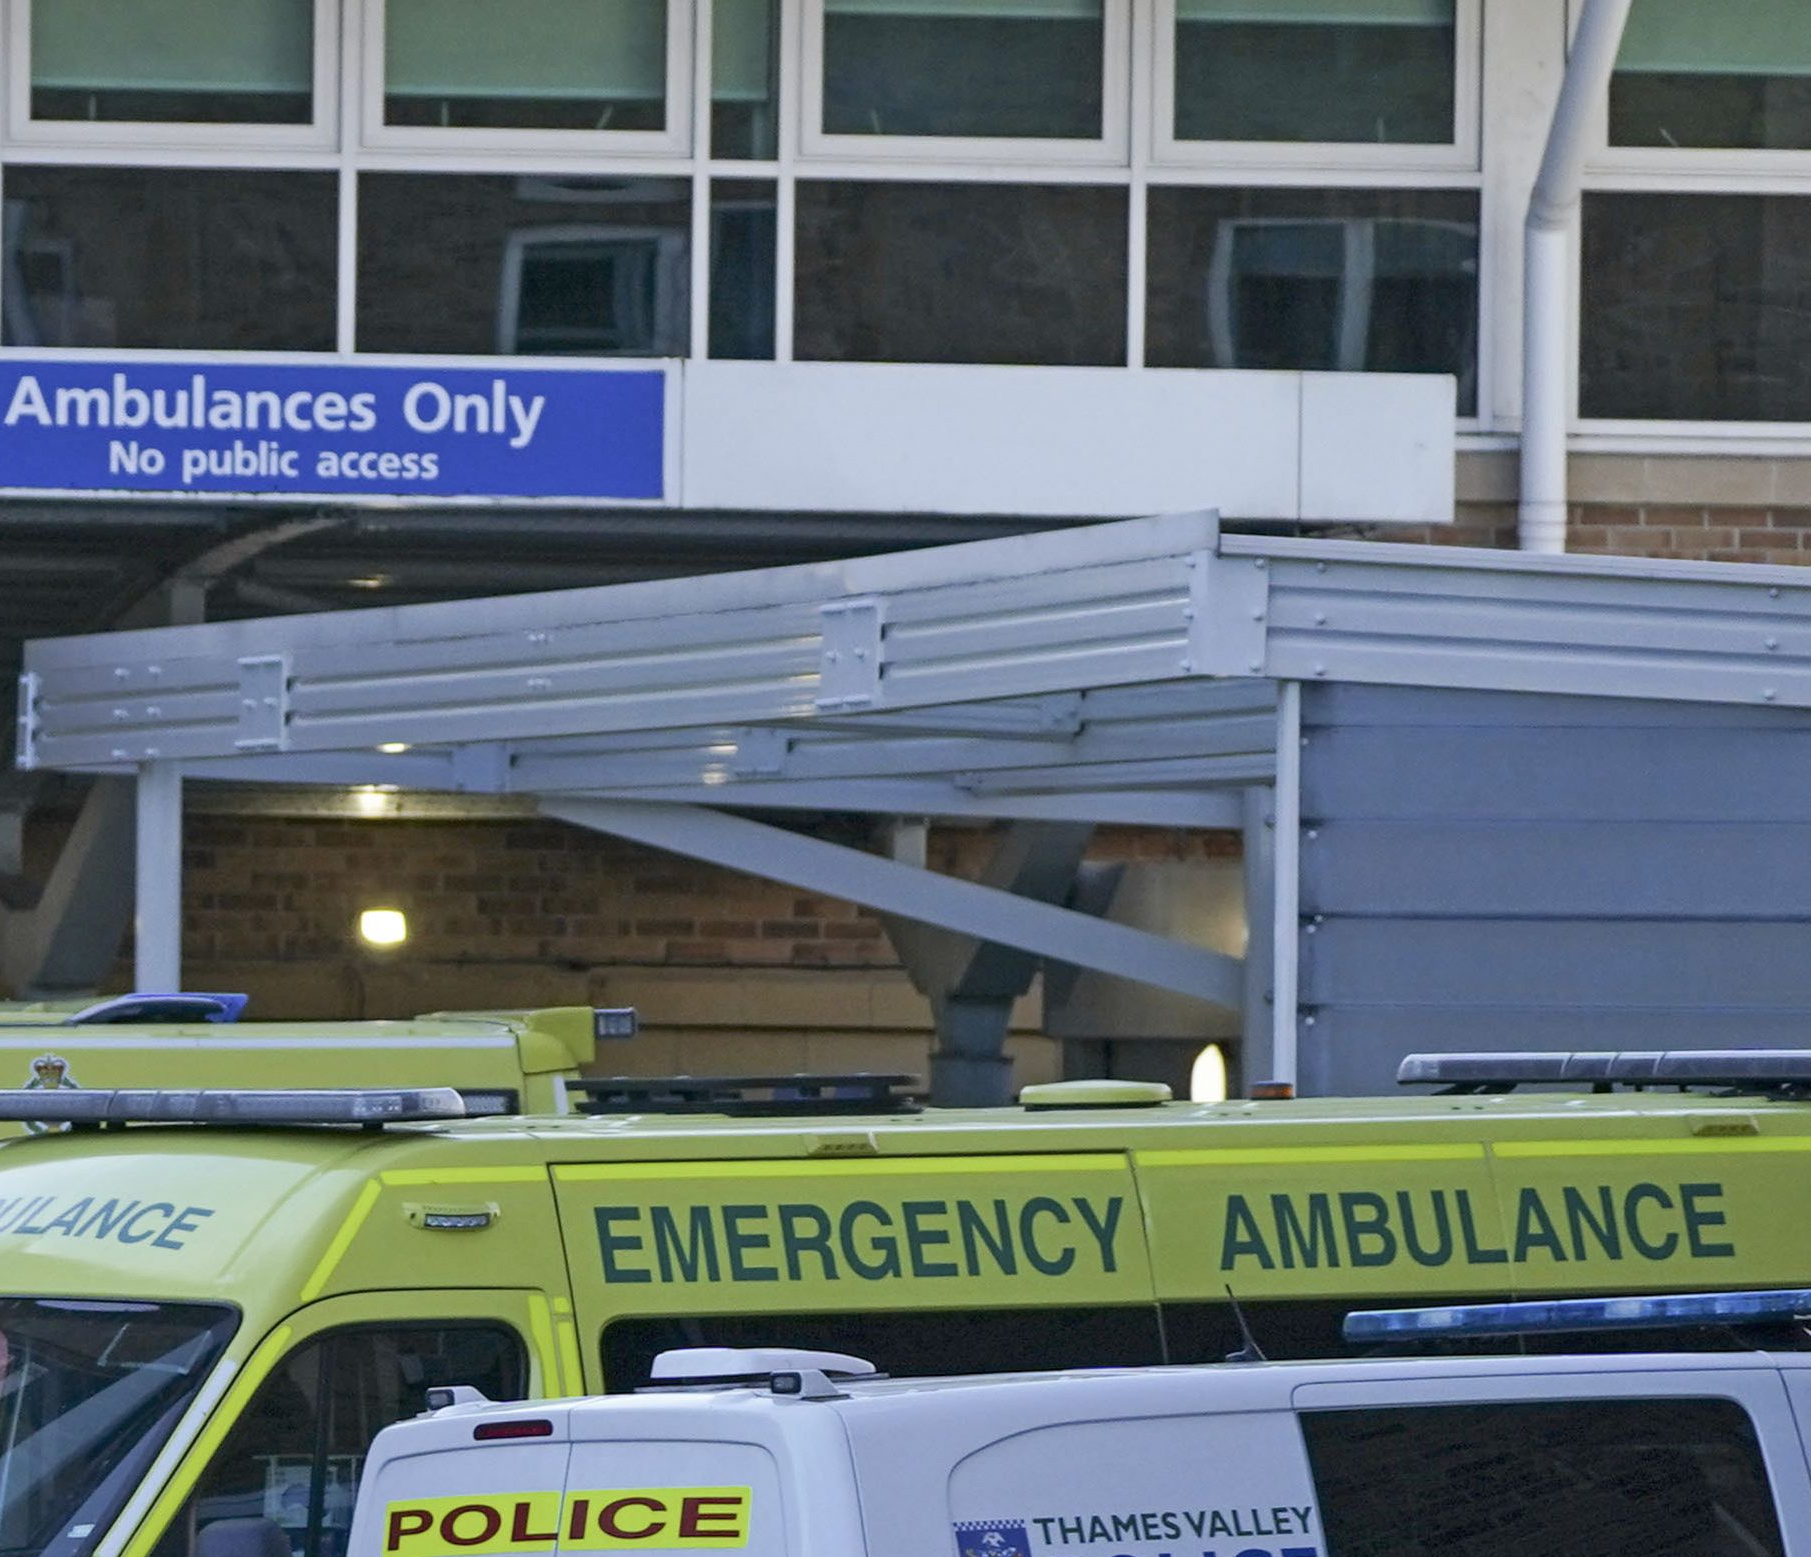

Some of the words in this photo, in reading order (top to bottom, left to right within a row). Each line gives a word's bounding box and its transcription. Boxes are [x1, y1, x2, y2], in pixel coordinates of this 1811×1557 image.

[3, 372, 377, 432] Ambulances
[402, 378, 545, 449] Only
[108, 440, 166, 475] No
[182, 440, 300, 485] public
[315, 448, 440, 480] access
[594, 1194, 1125, 1285] EMERGENCY
[1220, 1182, 1736, 1271] AMBULANCE
[386, 1495, 744, 1552] POLICE
[1032, 1510, 1182, 1545] THAMES
[1182, 1505, 1313, 1540] VALLEY
